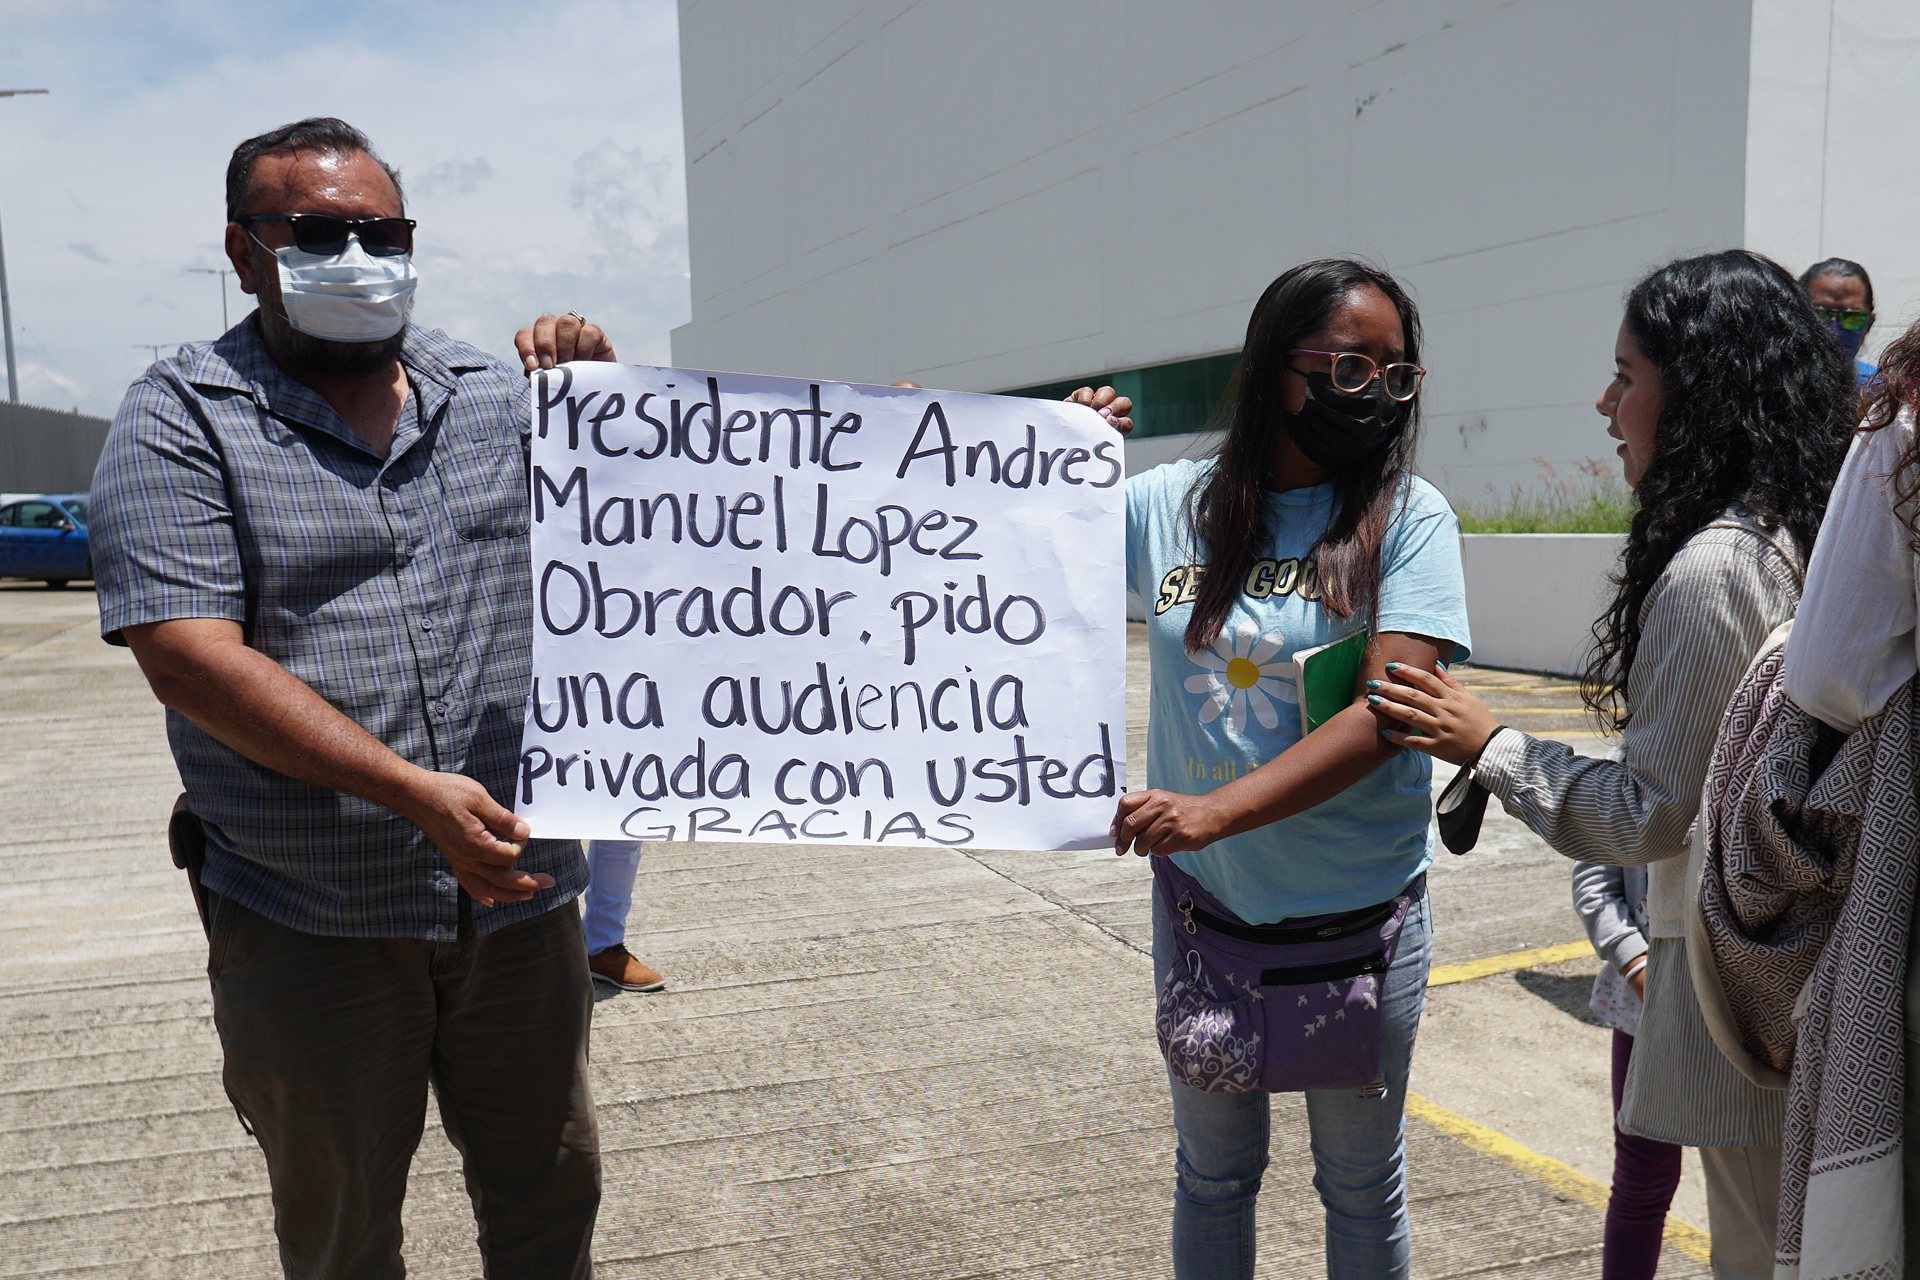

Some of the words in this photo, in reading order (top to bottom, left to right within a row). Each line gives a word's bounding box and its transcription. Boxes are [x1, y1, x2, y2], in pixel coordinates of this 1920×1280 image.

[535, 366, 863, 473] Presidente
[896, 401, 1124, 489] Andres
[532, 465, 788, 553] Manuel
[811, 483, 984, 577] Lopez
[890, 574, 1048, 666] pido
[532, 672, 665, 735] una
[700, 661, 1031, 736] audiencia
[773, 757, 896, 806] con
[1187, 756, 1206, 779] In
[1212, 760, 1236, 781] all
[619, 806, 976, 846] GRACIAS
